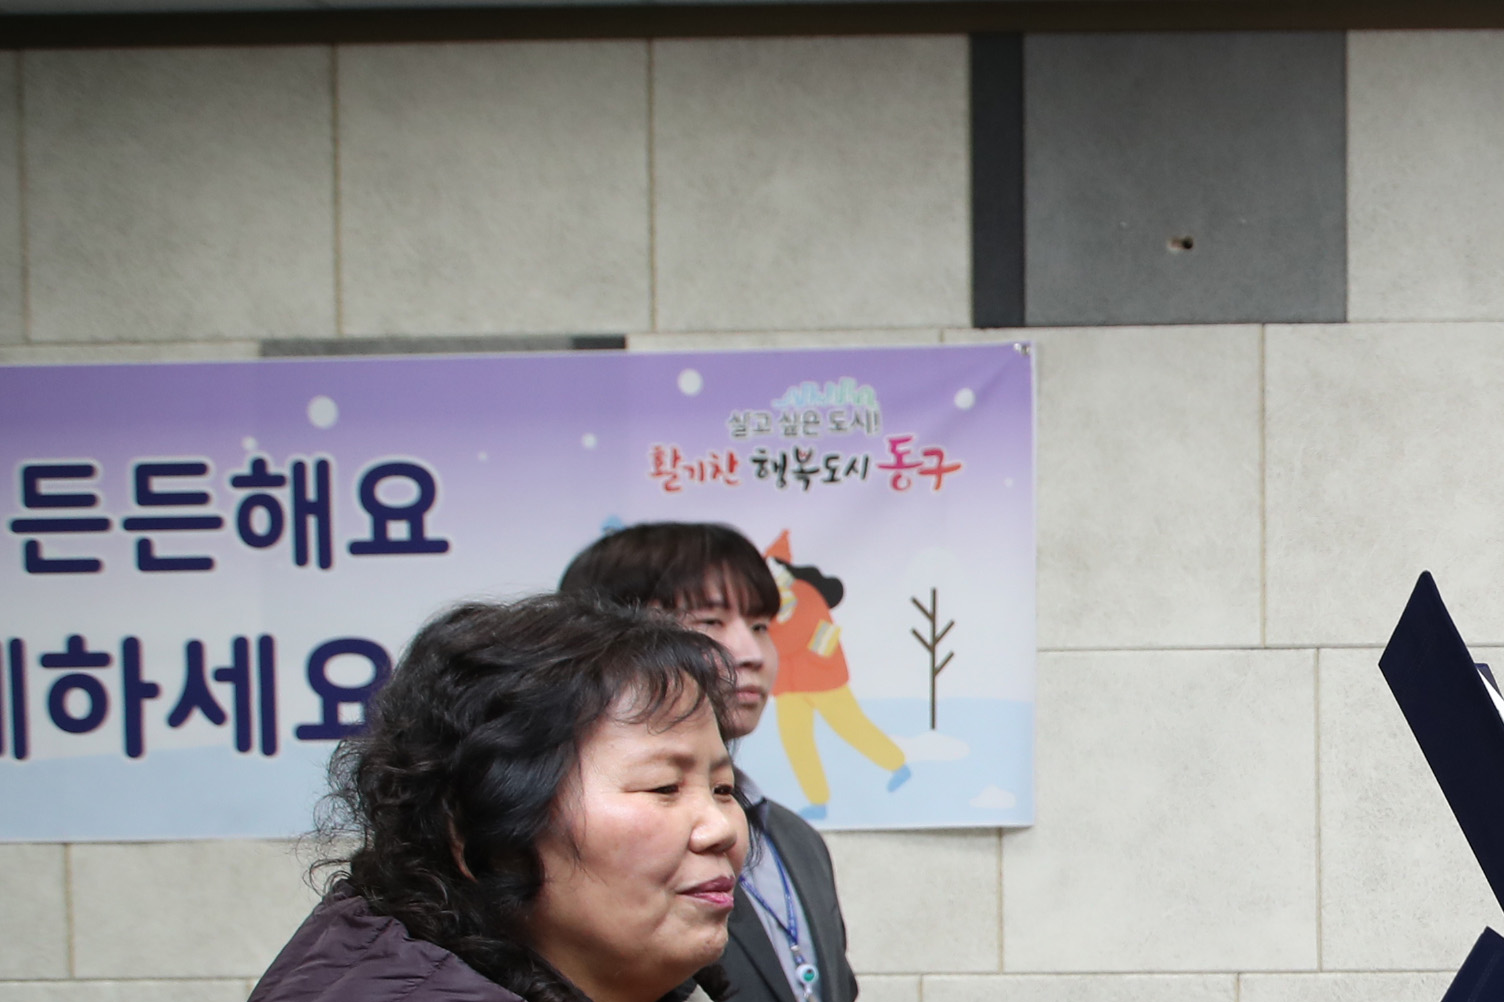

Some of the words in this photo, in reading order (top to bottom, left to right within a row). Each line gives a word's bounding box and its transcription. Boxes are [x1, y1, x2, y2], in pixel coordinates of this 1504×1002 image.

[728, 408, 772, 437] 살고
[778, 409, 821, 437] 싶은
[827, 408, 880, 435] 도시!
[650, 446, 740, 493] 활기찬
[875, 435, 962, 491] 동구
[9, 456, 452, 575] 든든해요
